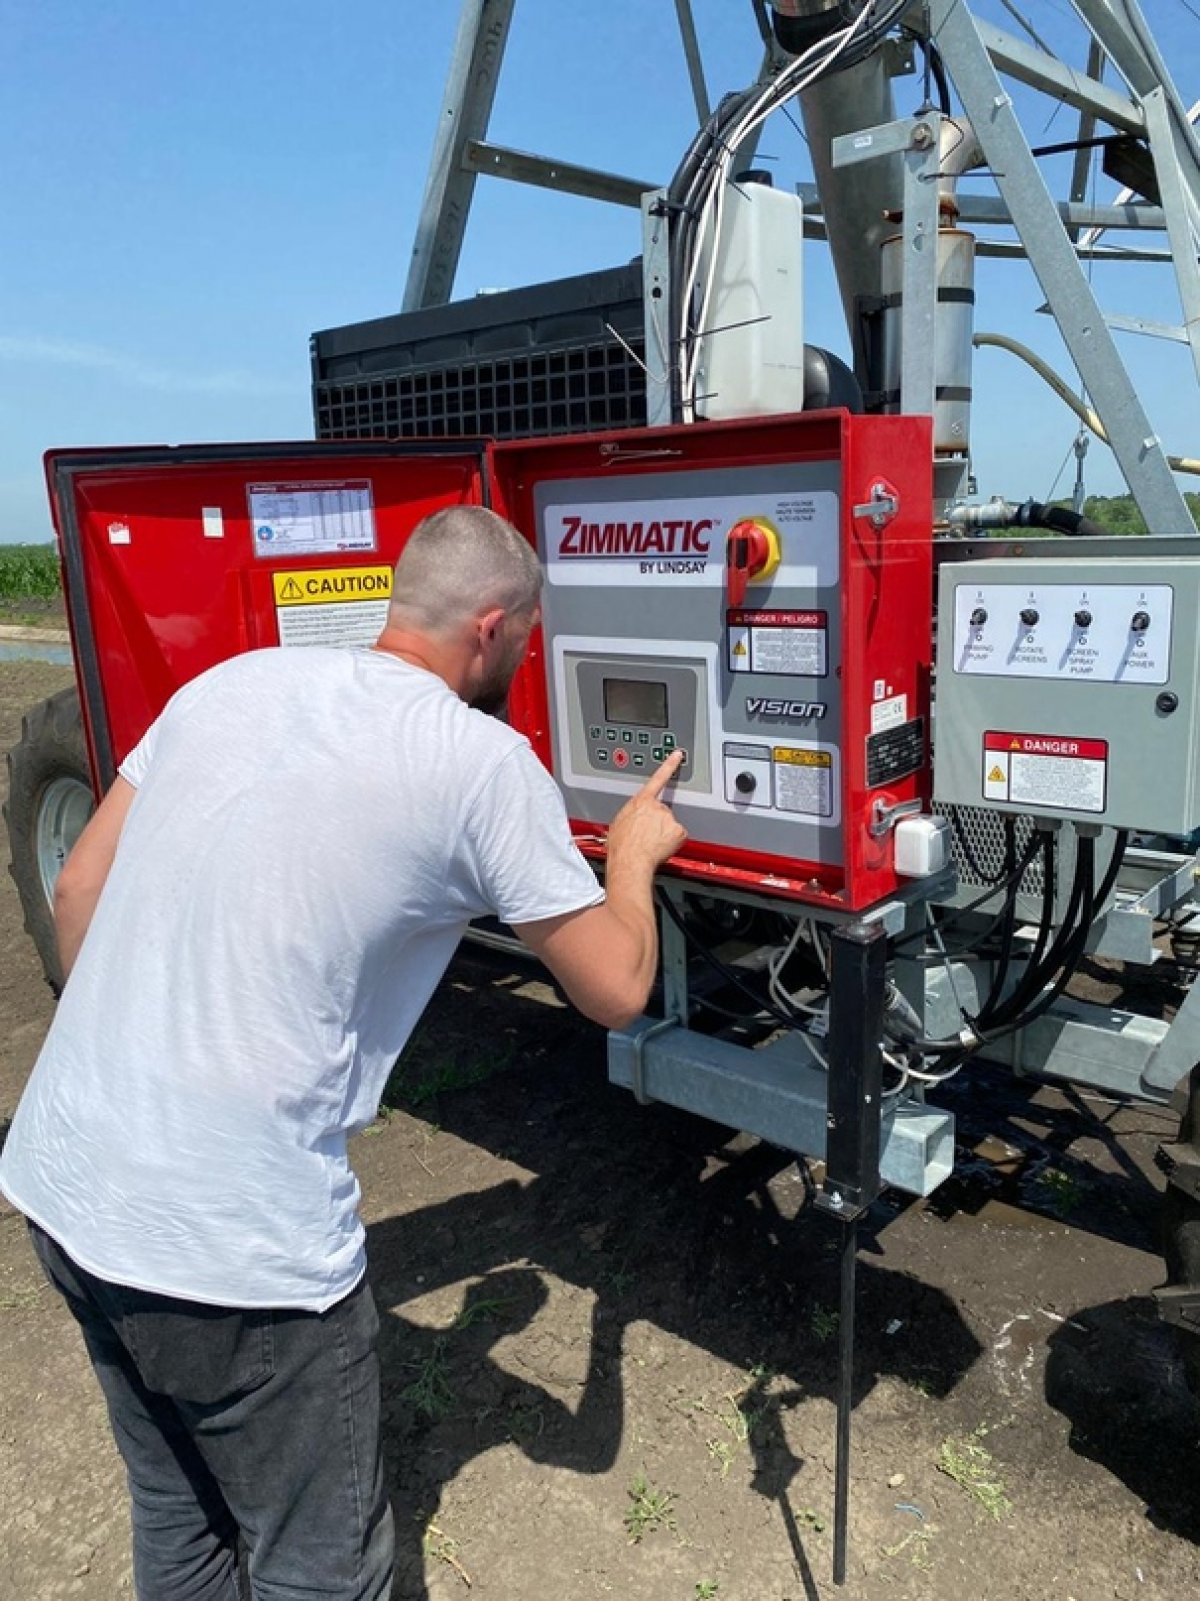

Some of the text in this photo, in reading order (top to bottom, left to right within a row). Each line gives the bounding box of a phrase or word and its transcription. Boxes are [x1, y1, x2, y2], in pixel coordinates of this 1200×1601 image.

[559, 516, 713, 554] ZIMMATIC
[640, 561, 707, 574] BY LINDSAY
[306, 575, 389, 595] CAUTION
[744, 614, 776, 624] DANGER
[782, 615, 818, 624] PELIGRO
[1070, 666, 1094, 674] PUMP
[1024, 739, 1079, 755] DANGER
